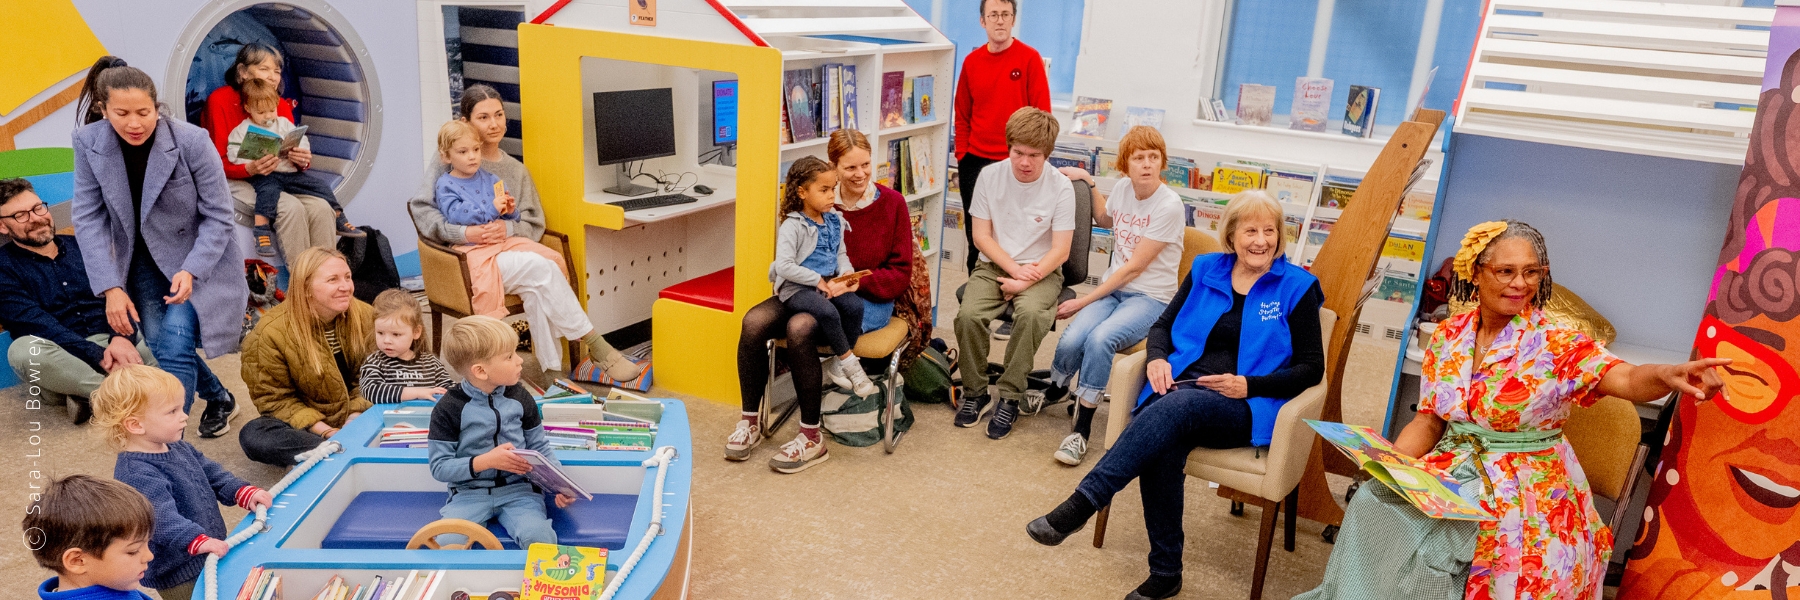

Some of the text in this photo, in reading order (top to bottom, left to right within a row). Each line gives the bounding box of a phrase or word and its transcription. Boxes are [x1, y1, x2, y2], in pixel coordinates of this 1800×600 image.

[1301, 82, 1328, 92] Choose
[1197, 210, 1221, 220] DINOSA
[1388, 241, 1414, 251] DYLAN
[1393, 280, 1416, 290] Santa
[395, 370, 424, 379] Paris
[533, 580, 589, 596] DINOSAUR
